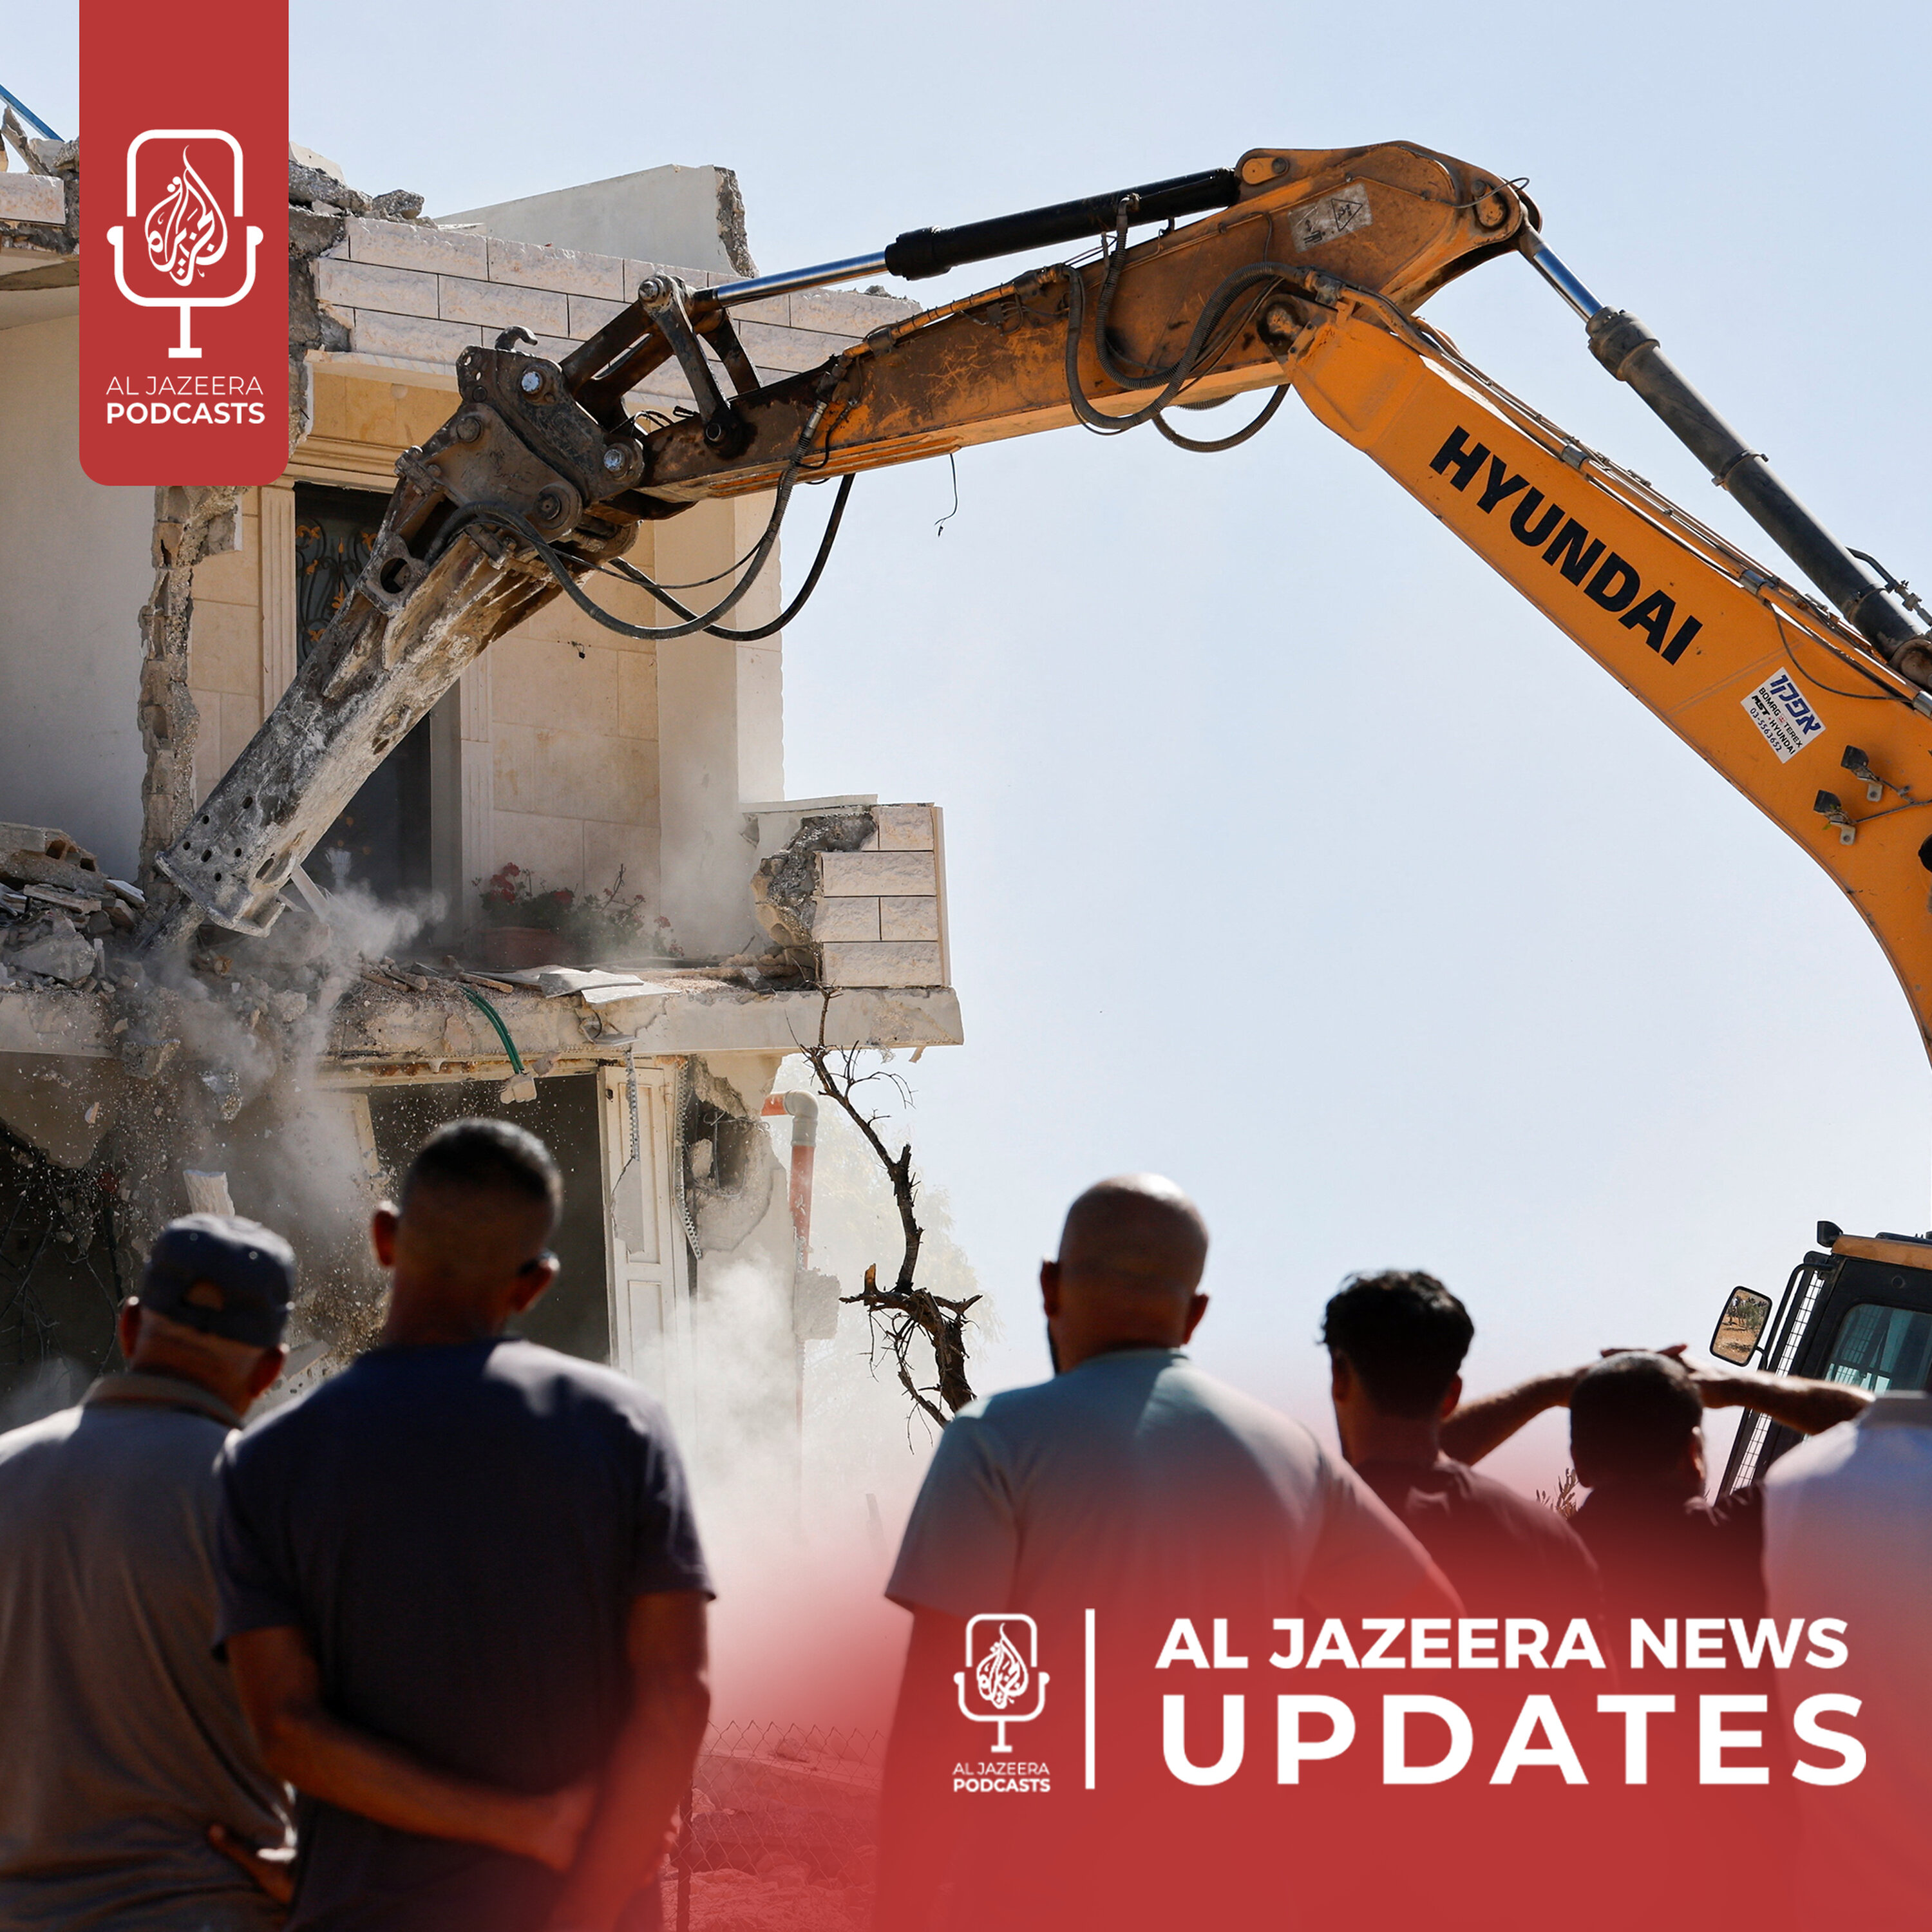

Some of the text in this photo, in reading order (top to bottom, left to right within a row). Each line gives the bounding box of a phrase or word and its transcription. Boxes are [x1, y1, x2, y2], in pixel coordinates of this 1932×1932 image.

[1429, 425, 1703, 666] HYUNDAI
[1750, 708, 1782, 752] 03-5563652
[1752, 695, 1796, 755] MST HYUNDAI
[1759, 687, 1803, 748] BOMAG TEREX
[1770, 674, 1821, 735] אפקו
